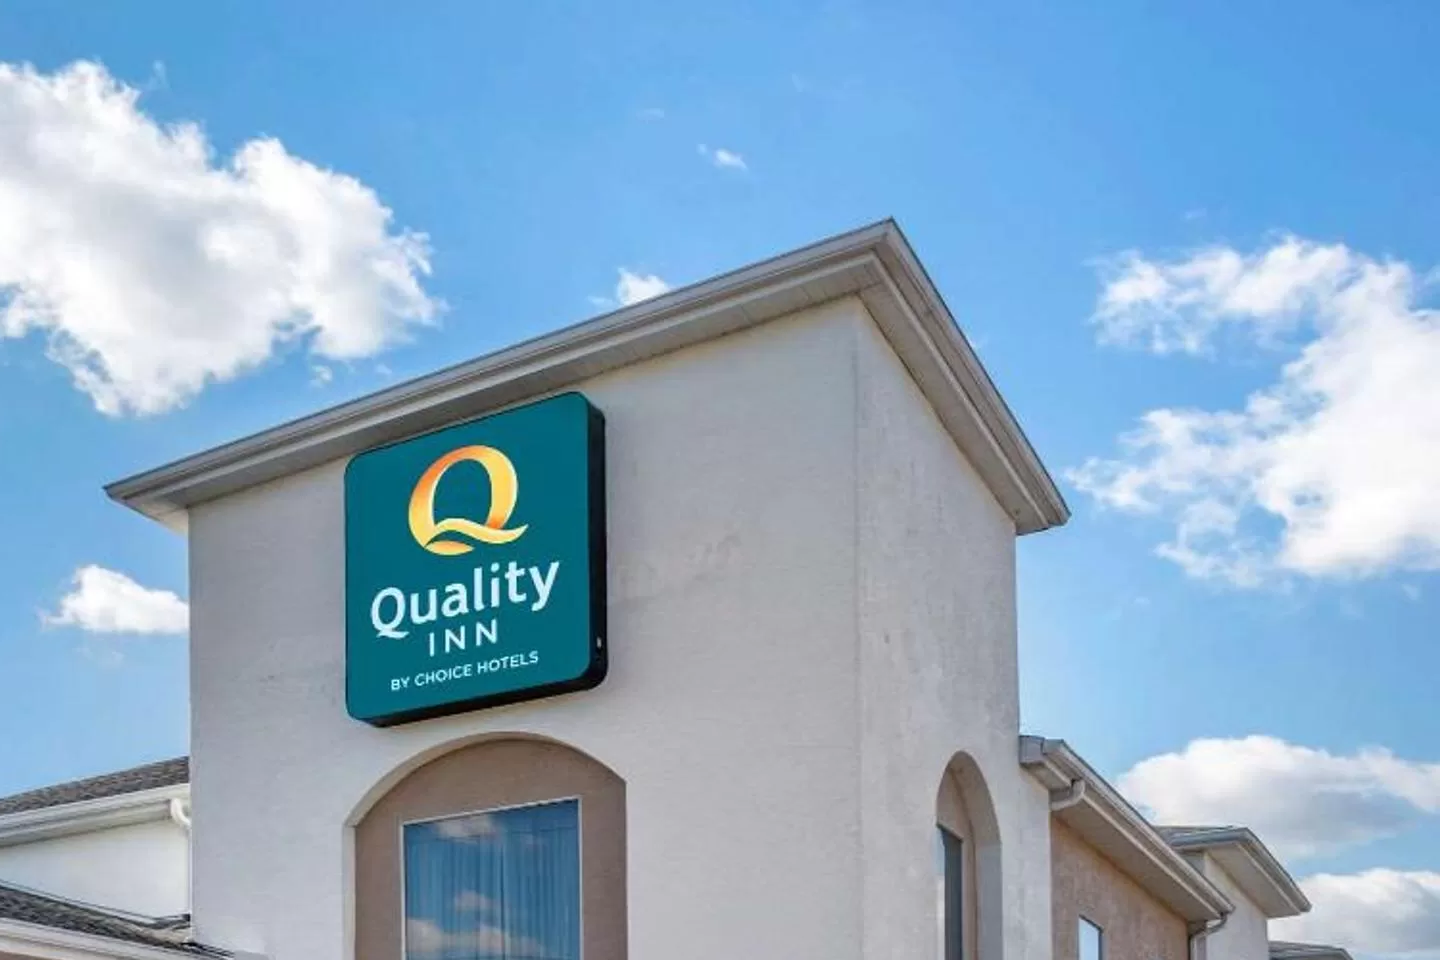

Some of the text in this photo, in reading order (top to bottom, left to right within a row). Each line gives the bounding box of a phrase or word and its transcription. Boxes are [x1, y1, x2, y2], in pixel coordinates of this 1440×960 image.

[408, 445, 529, 556] Q
[370, 561, 560, 639] Quality
[429, 619, 498, 657] INN
[390, 650, 539, 691] BY CHOICE HOTELS
